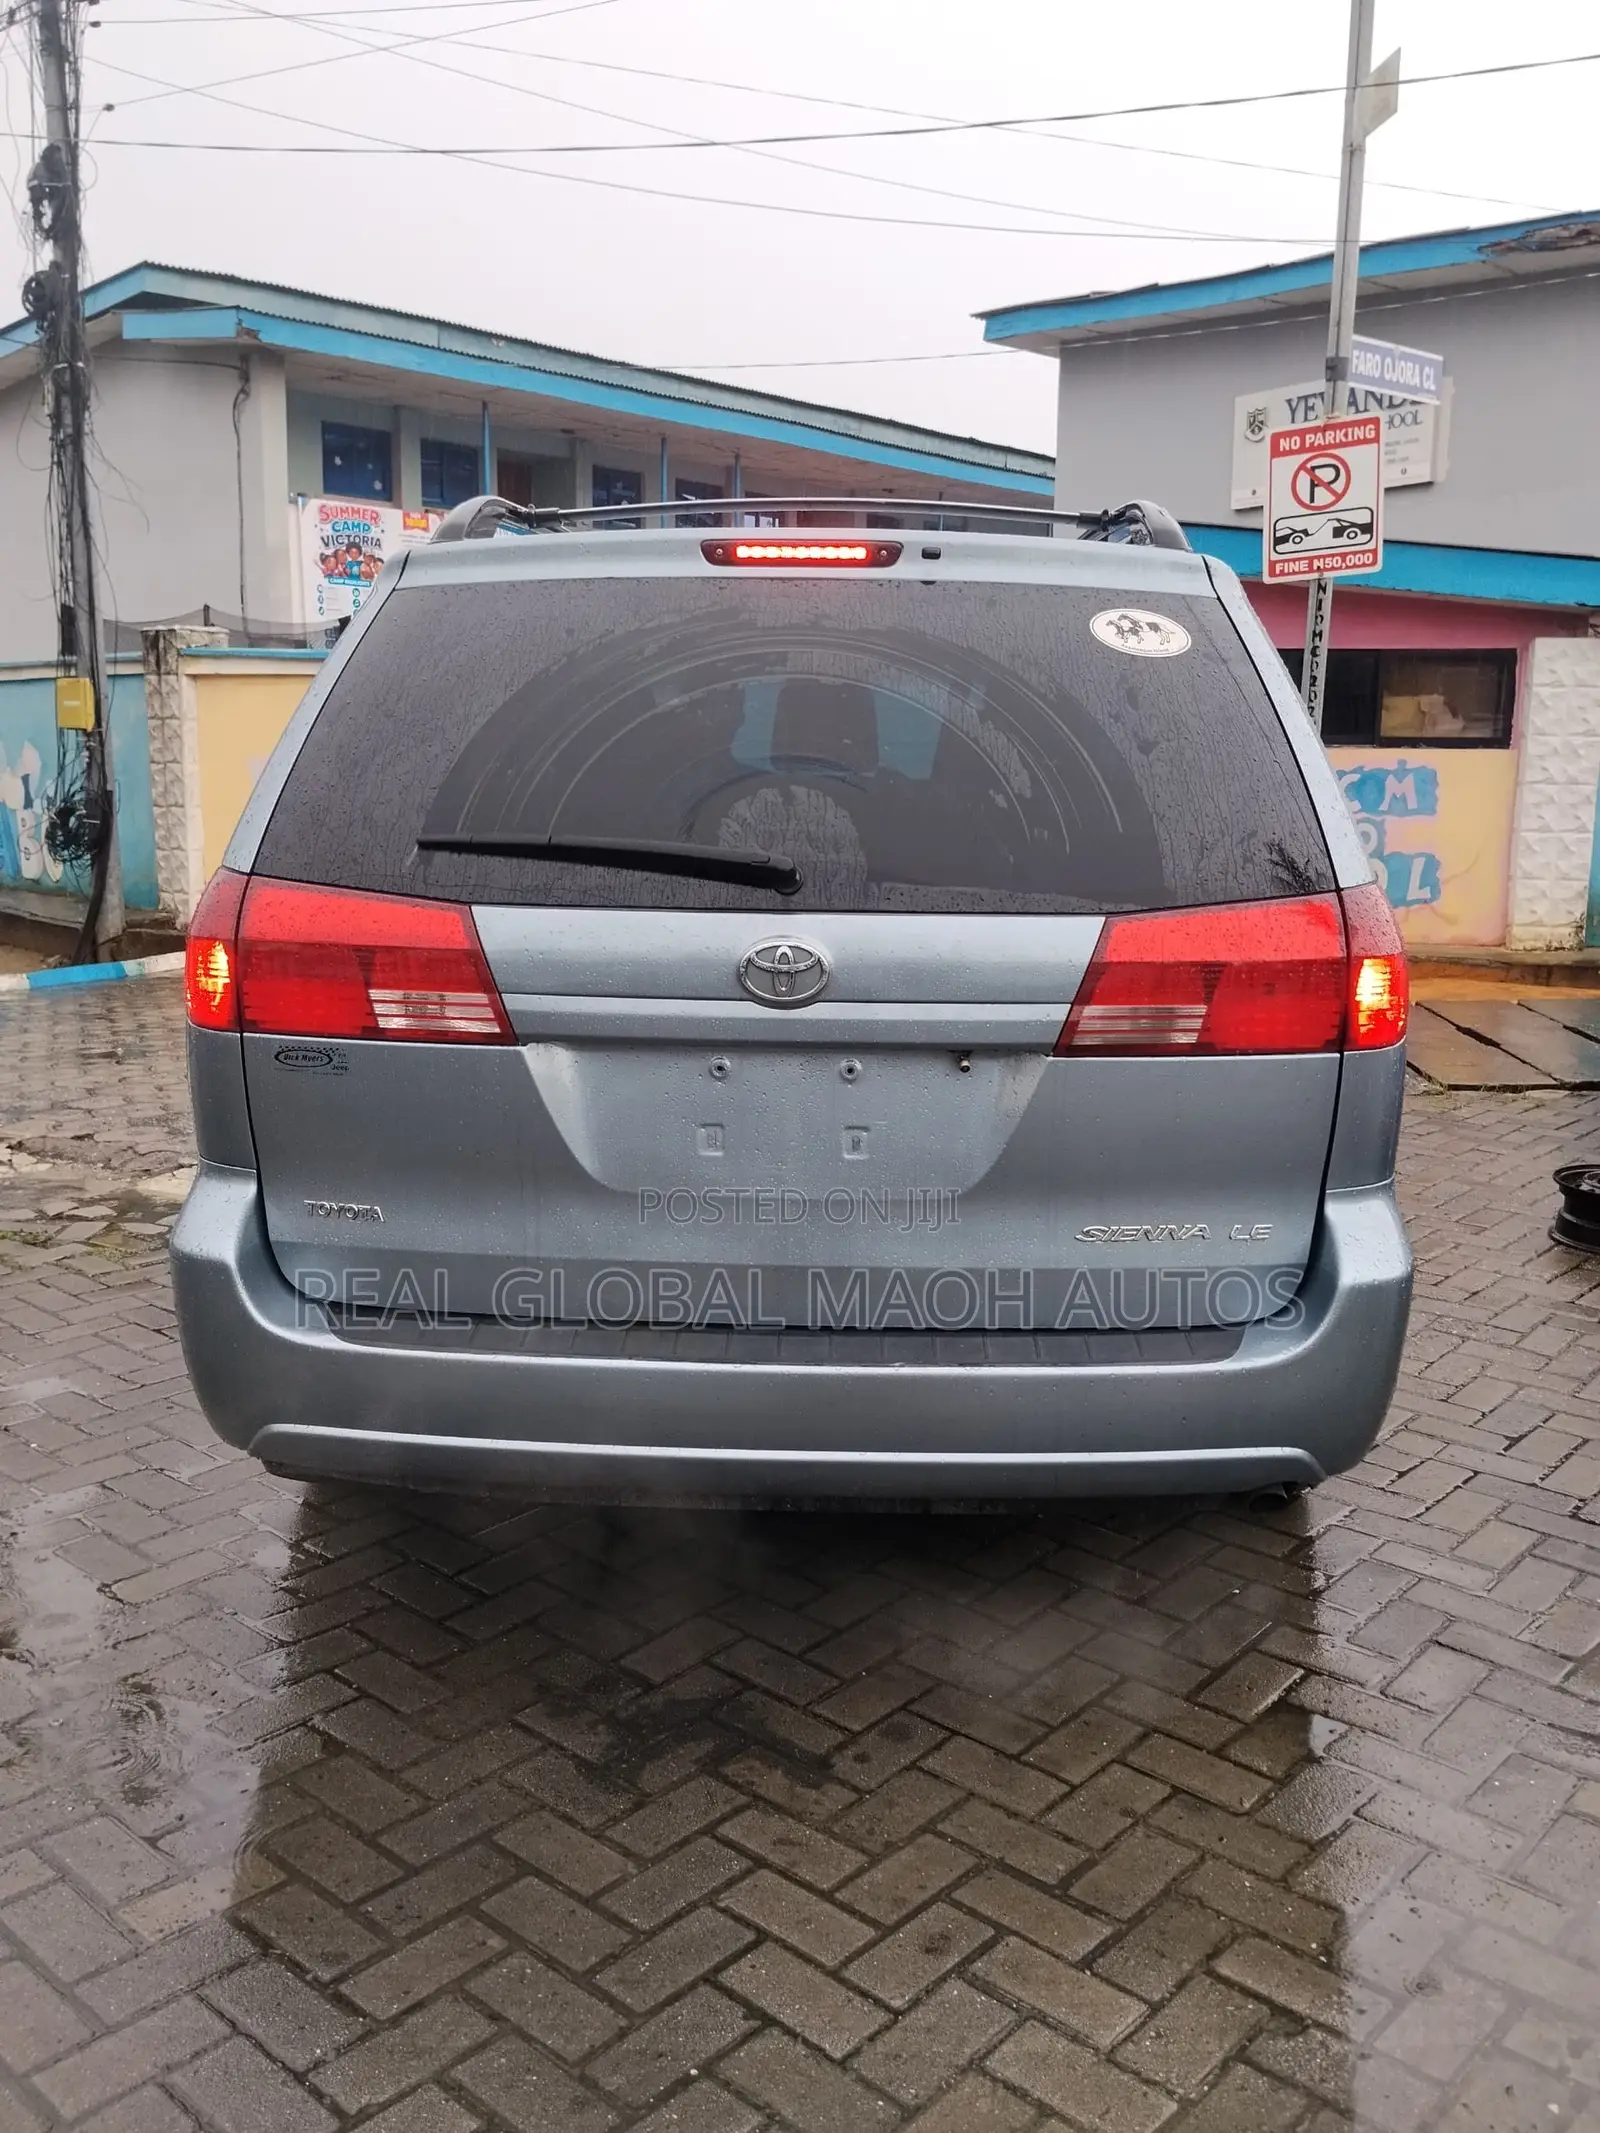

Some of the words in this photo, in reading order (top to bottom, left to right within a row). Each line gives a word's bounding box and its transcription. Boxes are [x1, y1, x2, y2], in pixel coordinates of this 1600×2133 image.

[1352, 350, 1380, 378] FARO
[1384, 358, 1420, 388] OJORA
[1423, 367, 1437, 391] CL
[1285, 387, 1426, 424] YEAND
[1280, 435, 1301, 452] NO
[1305, 424, 1376, 447] PARKING
[1309, 463, 1341, 504] P
[319, 504, 381, 526] SUMMER
[331, 521, 371, 534] CAMP
[320, 534, 382, 549] VICTORIA
[1275, 560, 1309, 575] FINE
[303, 1200, 385, 1222] TOYOTA
[1074, 1224, 1212, 1242] SIENNA
[1229, 1224, 1274, 1241] LE
